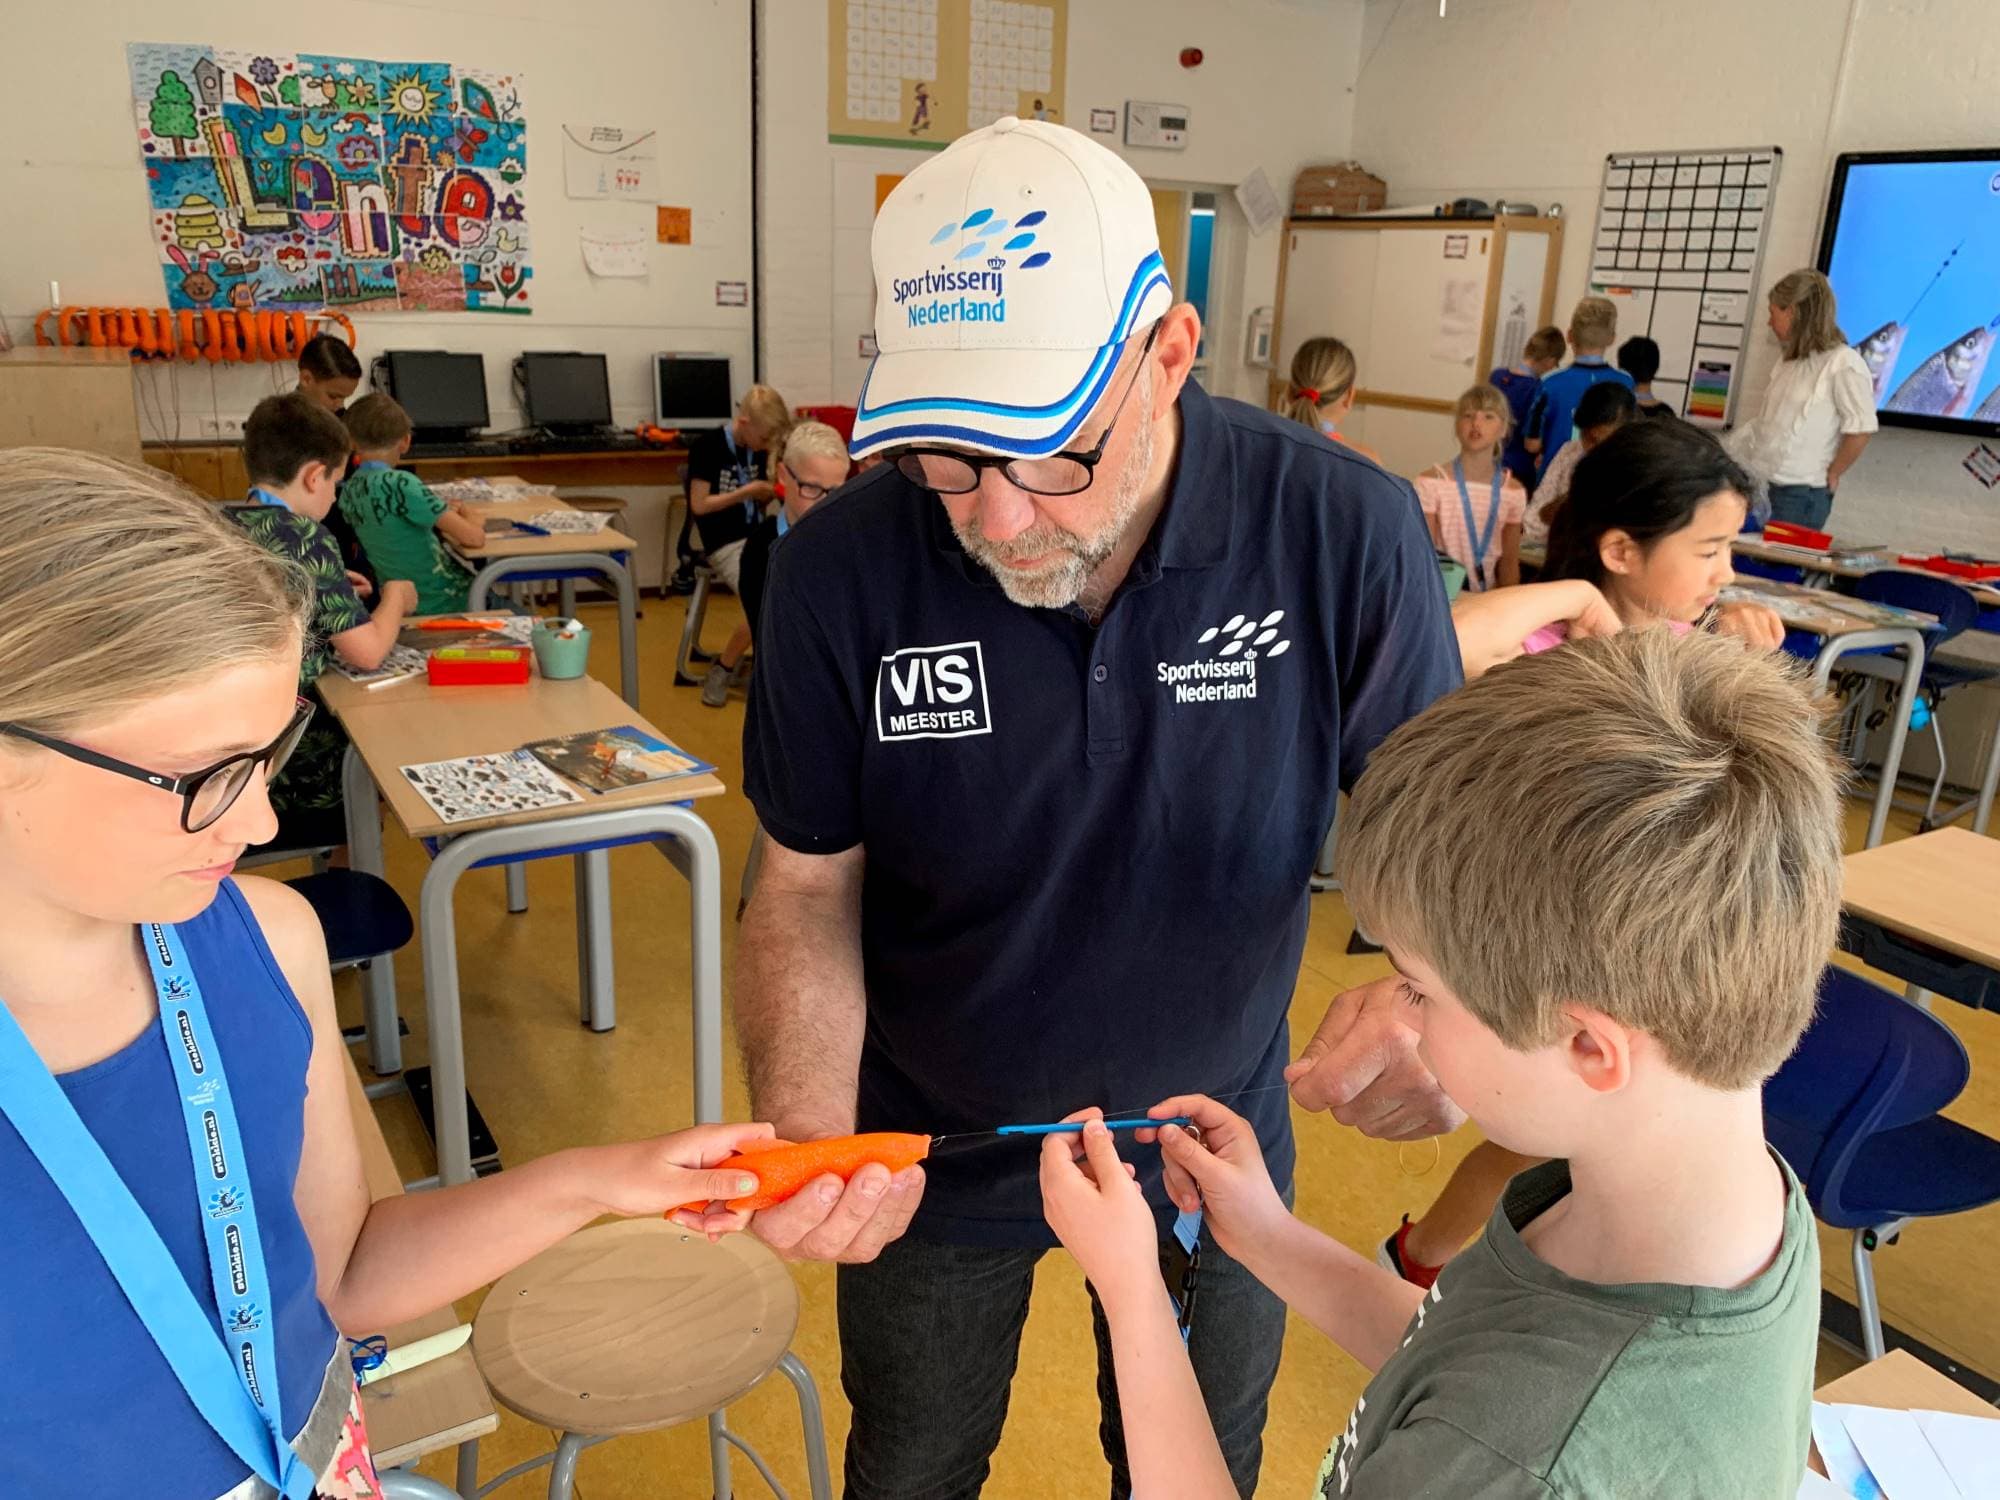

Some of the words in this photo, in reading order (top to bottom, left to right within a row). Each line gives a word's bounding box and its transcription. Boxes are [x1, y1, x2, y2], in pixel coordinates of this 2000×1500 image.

[203, 118, 494, 258] Lente
[893, 265, 1002, 304] Sportvisserij
[908, 297, 1005, 328] Nederland
[890, 655, 973, 706] VIS
[1157, 658, 1256, 686] Sportvisserij
[1175, 678, 1257, 704] Nederland
[890, 710, 977, 732] MEESTER
[153, 923, 171, 962] stekkie
[178, 1015, 202, 1070] stekkie.nl
[204, 1115, 225, 1174] stekkie.nl
[227, 1230, 245, 1291] stekkie.nl
